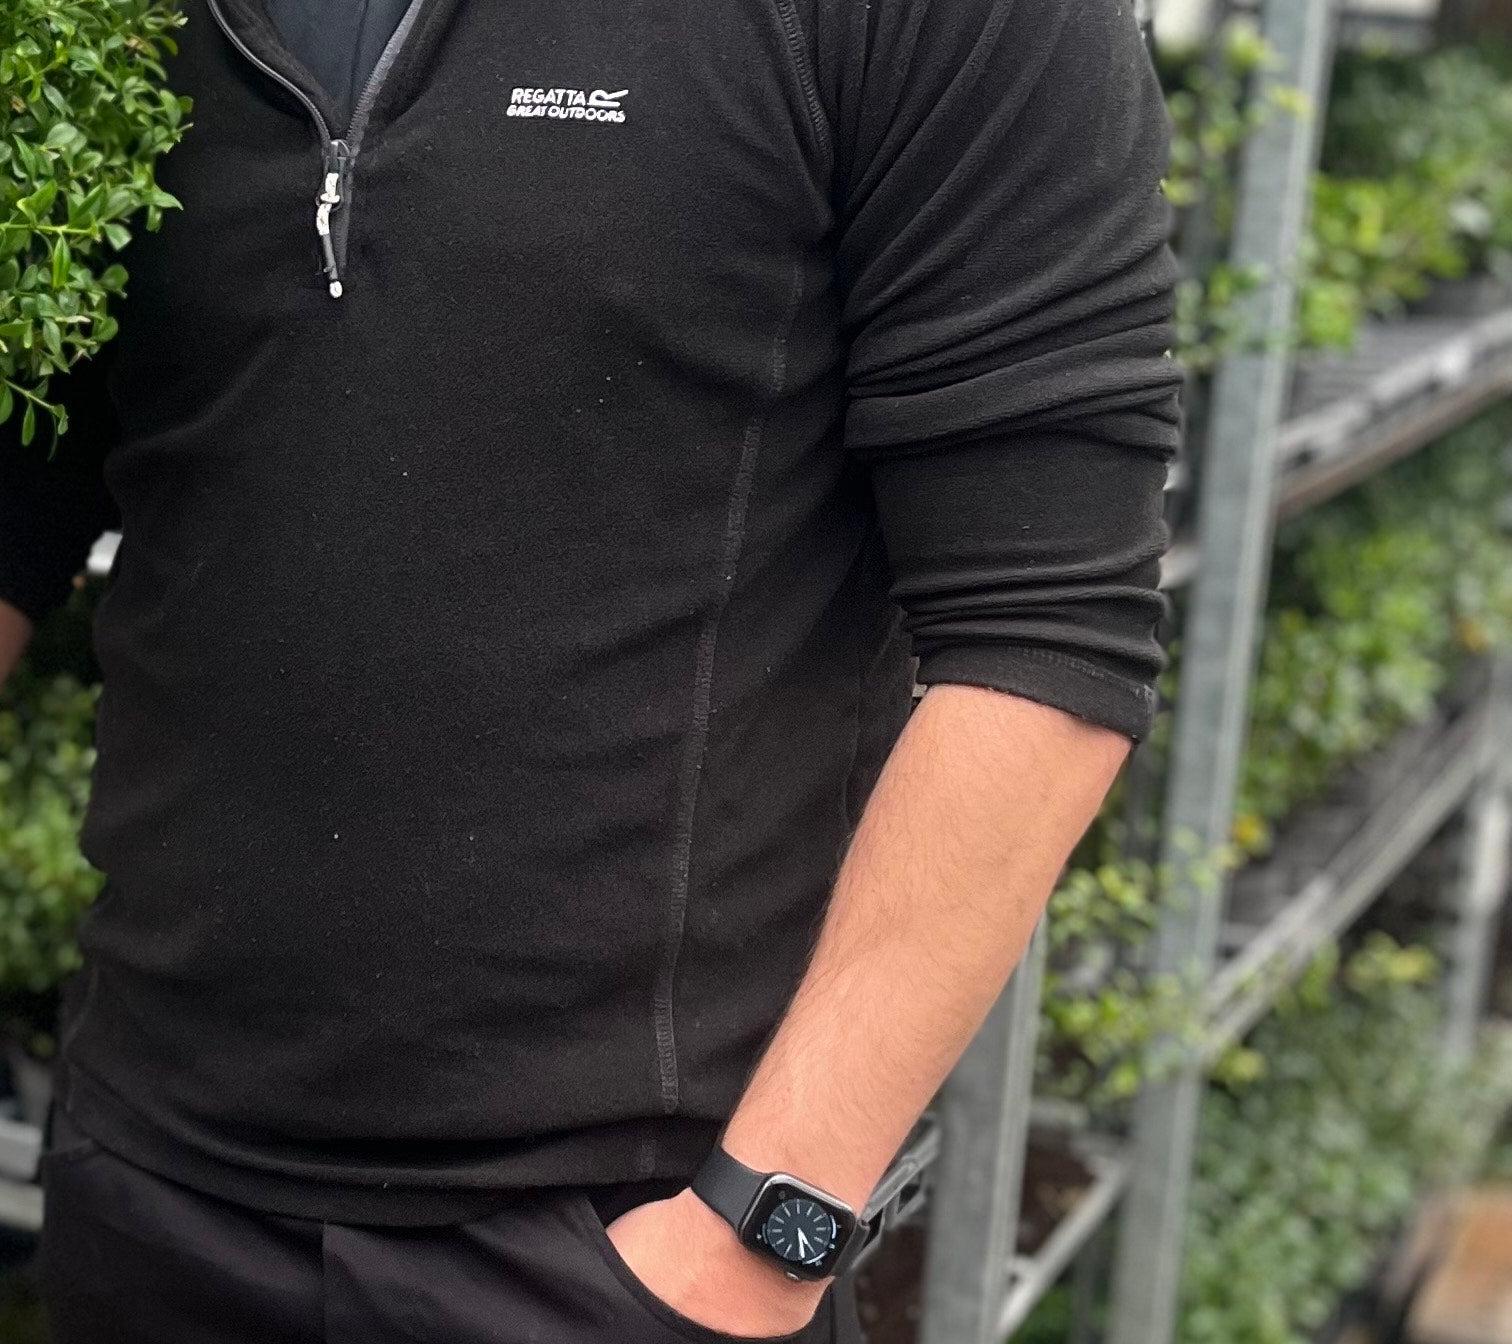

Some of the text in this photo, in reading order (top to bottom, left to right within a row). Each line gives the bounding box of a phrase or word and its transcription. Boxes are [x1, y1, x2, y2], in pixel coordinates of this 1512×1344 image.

[511, 88, 586, 106] REGATTA
[506, 105, 626, 123] GREAT OUTDOORS
